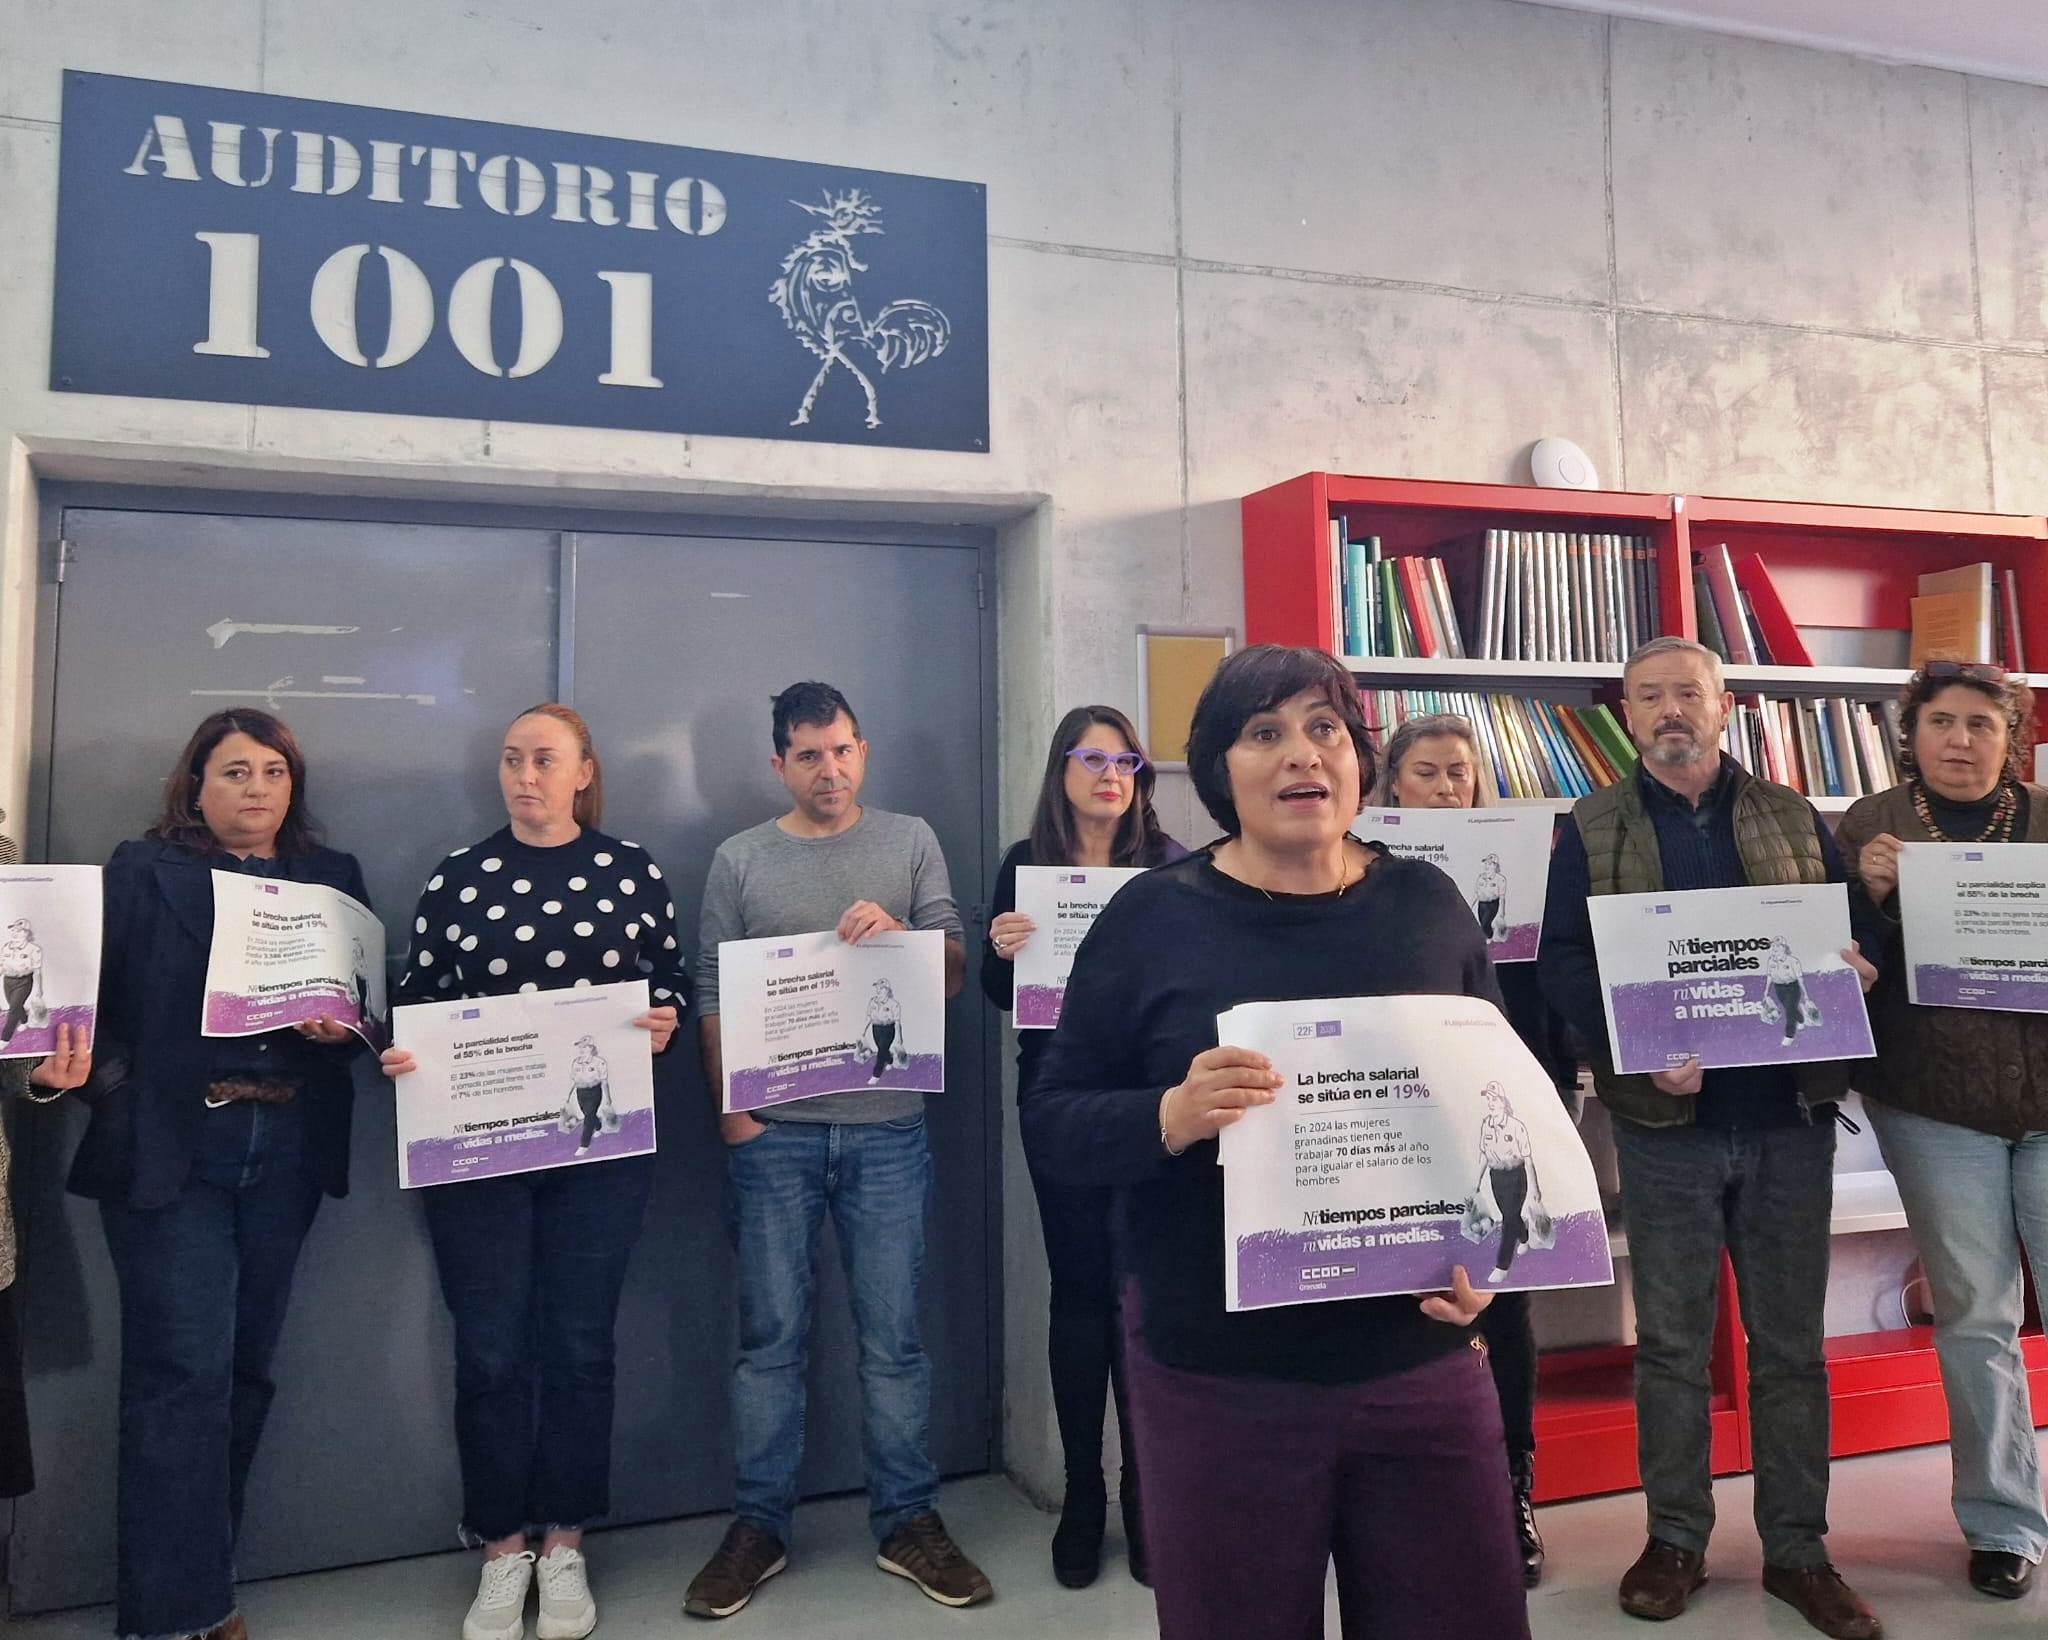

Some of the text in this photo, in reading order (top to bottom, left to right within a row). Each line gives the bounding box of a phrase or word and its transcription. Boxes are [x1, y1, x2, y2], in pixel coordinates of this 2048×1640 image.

[124, 114, 728, 237] AUDITORIO
[193, 231, 664, 388] 1001
[1414, 844, 1444, 852] salarial
[1428, 853, 1449, 862] 19%
[253, 909, 321, 922] La brecha salarial
[261, 921, 279, 930] sitúa
[295, 922, 303, 930] el
[306, 920, 327, 929] 19%
[1668, 938, 1771, 956] Ni tiempos
[1668, 954, 1760, 978] parciales
[1970, 958, 2016, 967] tiempos
[767, 969, 834, 986] La brecha salarial
[258, 981, 302, 992] tiempos
[778, 986, 798, 995] sitúa
[811, 982, 818, 990] el
[820, 979, 840, 989] 19%
[1689, 981, 1745, 1000] vidas
[258, 994, 287, 1006] vidas
[1674, 1005, 1688, 1020] a
[1297, 1026, 1313, 1037] 22F
[454, 1032, 539, 1049] La parcialidad explica
[454, 1044, 533, 1060] el 55% de la brecha
[778, 1042, 857, 1061] tiempos parciales
[459, 1071, 476, 1080] 23%
[1298, 1066, 1419, 1085] La brecha salarial
[459, 1091, 471, 1099] 7%
[1298, 1084, 1430, 1104] se sitúa en el 19%
[464, 1119, 509, 1132] tiempos
[512, 1111, 561, 1127] parciales
[1295, 1118, 1390, 1134] En 2024 las mujeres
[463, 1136, 493, 1149] vidas
[495, 1135, 502, 1143] a
[1295, 1130, 1402, 1149] granadinas tienen que
[1296, 1142, 1429, 1161] trabajar 70 días más al año
[1296, 1155, 1432, 1176] para igualar el salario de los
[1296, 1176, 1340, 1187] hombres
[1302, 1200, 1466, 1226] Ni tiempos parciales
[1318, 1234, 1361, 1251] vidas
[1365, 1234, 1375, 1247] a
[1380, 1227, 1445, 1246] medias.
[1302, 1266, 1340, 1279] CCOO
